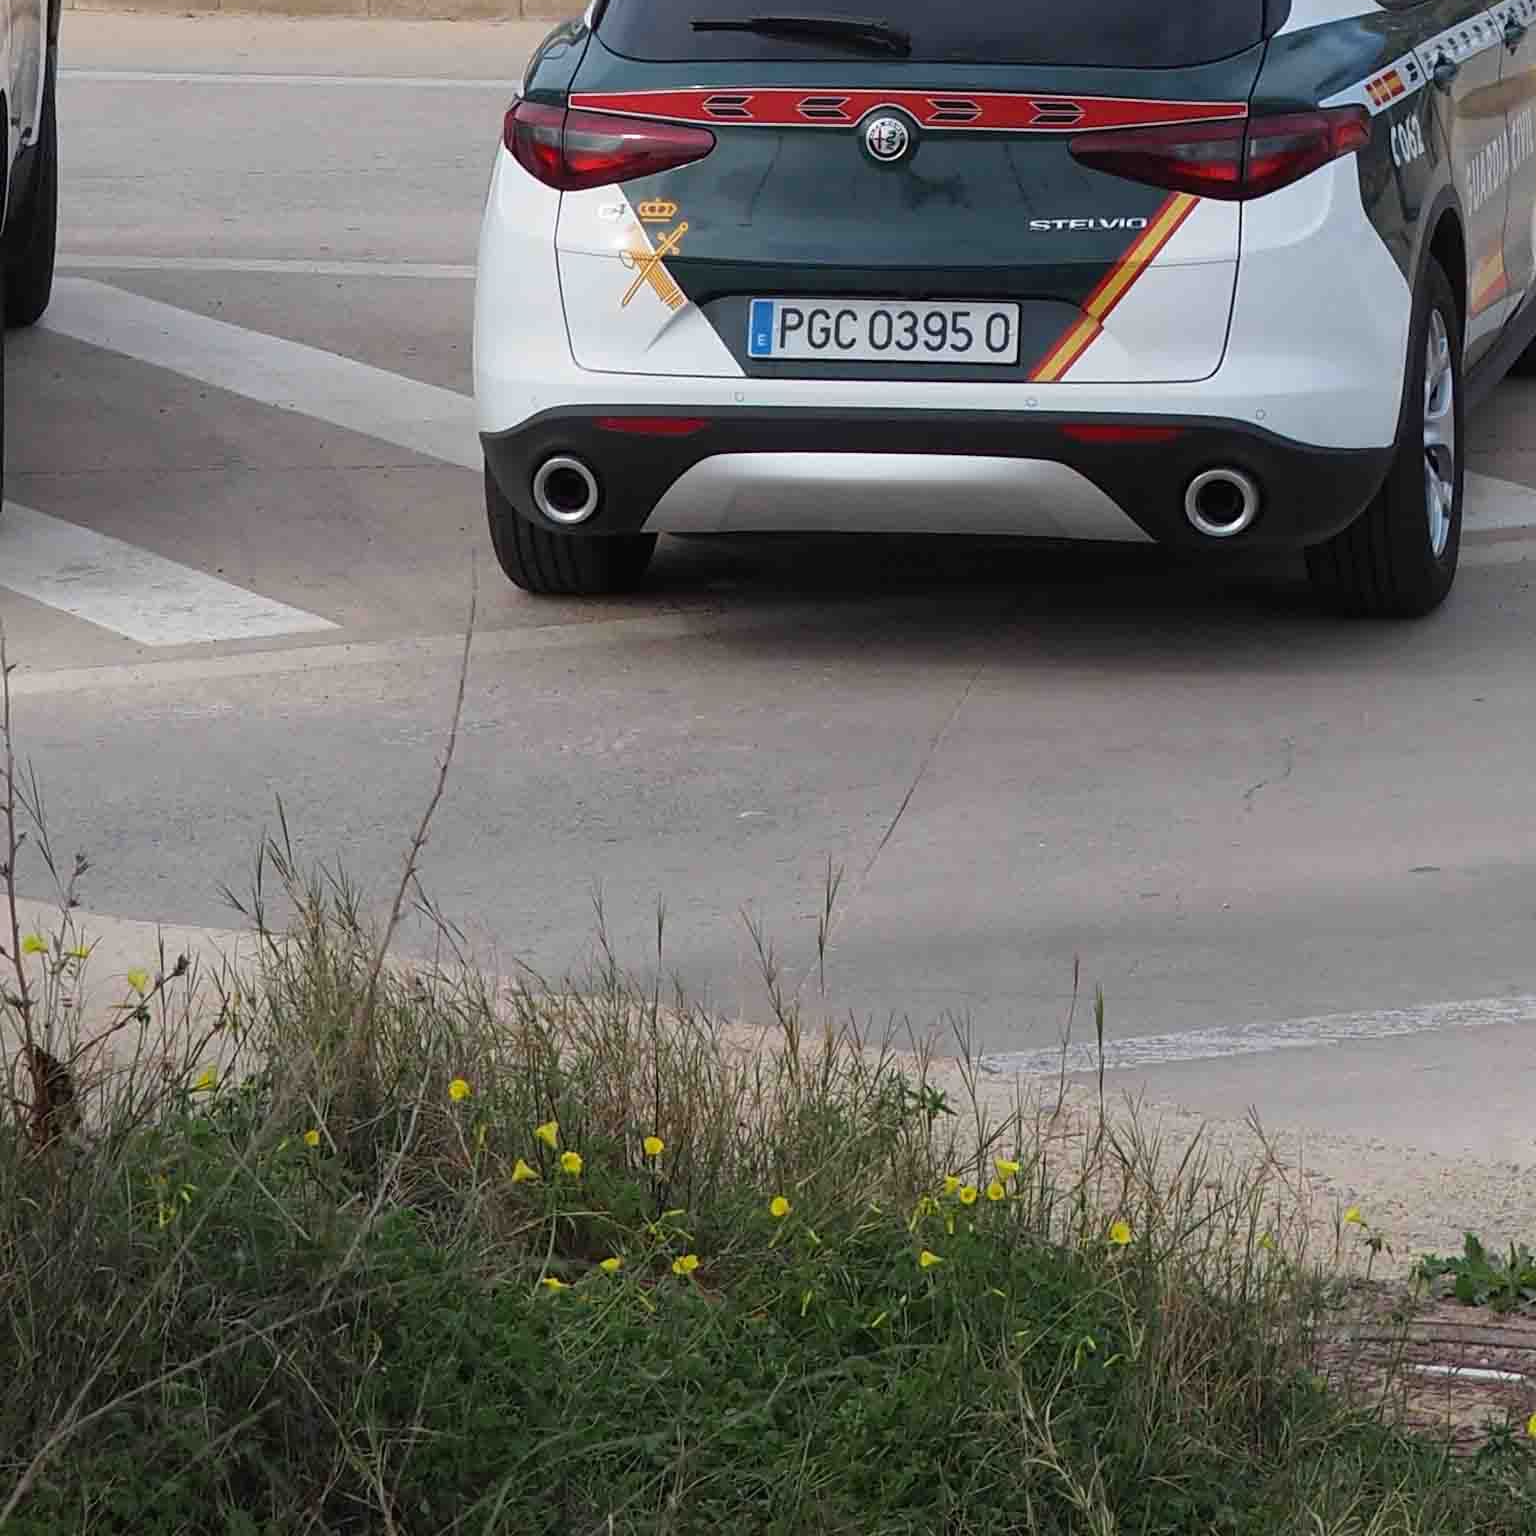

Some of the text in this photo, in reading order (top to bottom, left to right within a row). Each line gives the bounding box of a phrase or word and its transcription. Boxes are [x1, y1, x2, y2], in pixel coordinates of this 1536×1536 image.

[1029, 217, 1148, 232] STELVIO
[757, 332, 769, 347] E
[779, 307, 859, 350] PGC
[868, 310, 974, 352] 0395
